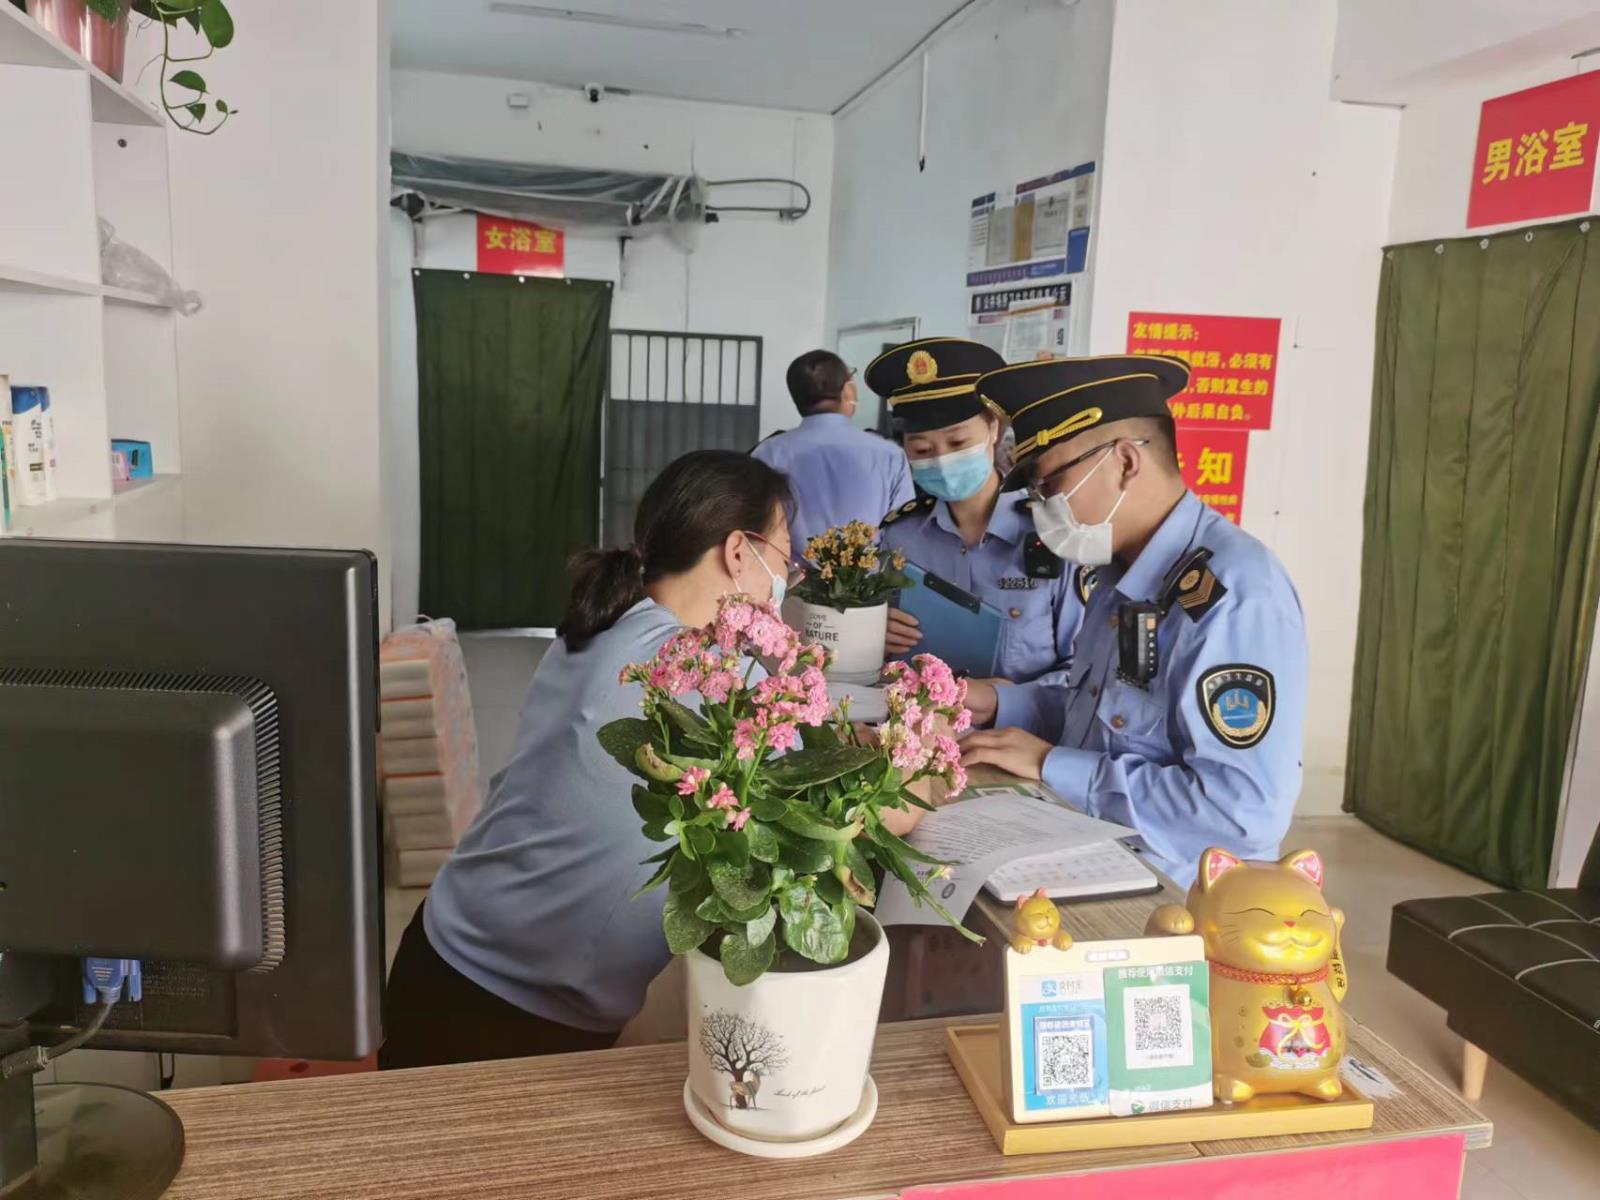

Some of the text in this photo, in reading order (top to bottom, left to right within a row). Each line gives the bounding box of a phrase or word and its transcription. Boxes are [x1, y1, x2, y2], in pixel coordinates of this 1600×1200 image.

[1482, 120, 1588, 184] 男浴室
[485, 226, 556, 253] 女浴室
[1184, 377, 1268, 395] ，否则发生的
[1171, 403, 1250, 420] 外后果自负。
